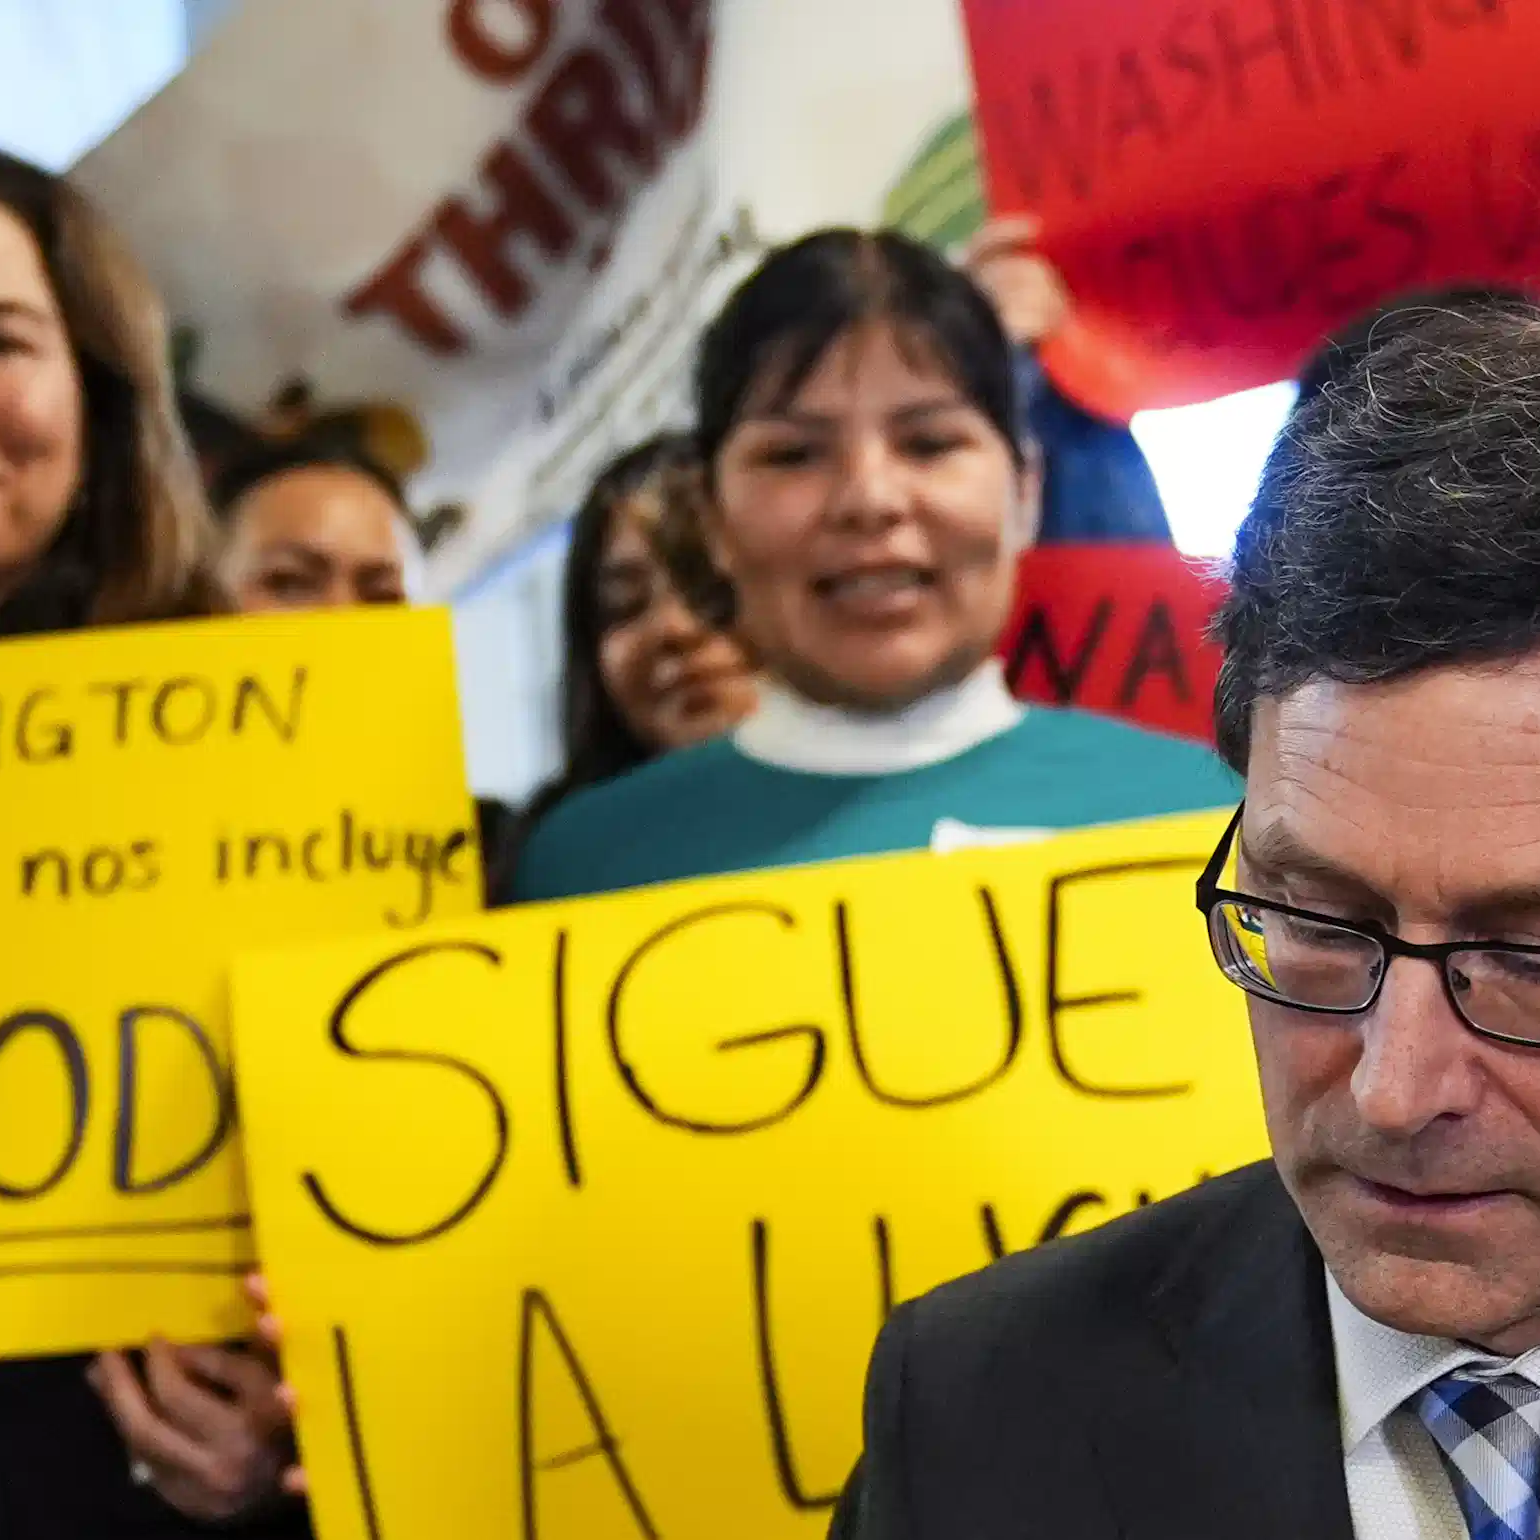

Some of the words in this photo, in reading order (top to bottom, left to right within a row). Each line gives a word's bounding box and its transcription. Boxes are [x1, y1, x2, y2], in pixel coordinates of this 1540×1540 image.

[20, 838, 162, 900] nos
[215, 808, 480, 930] incluye
[303, 855, 1212, 1247] SIGUE
